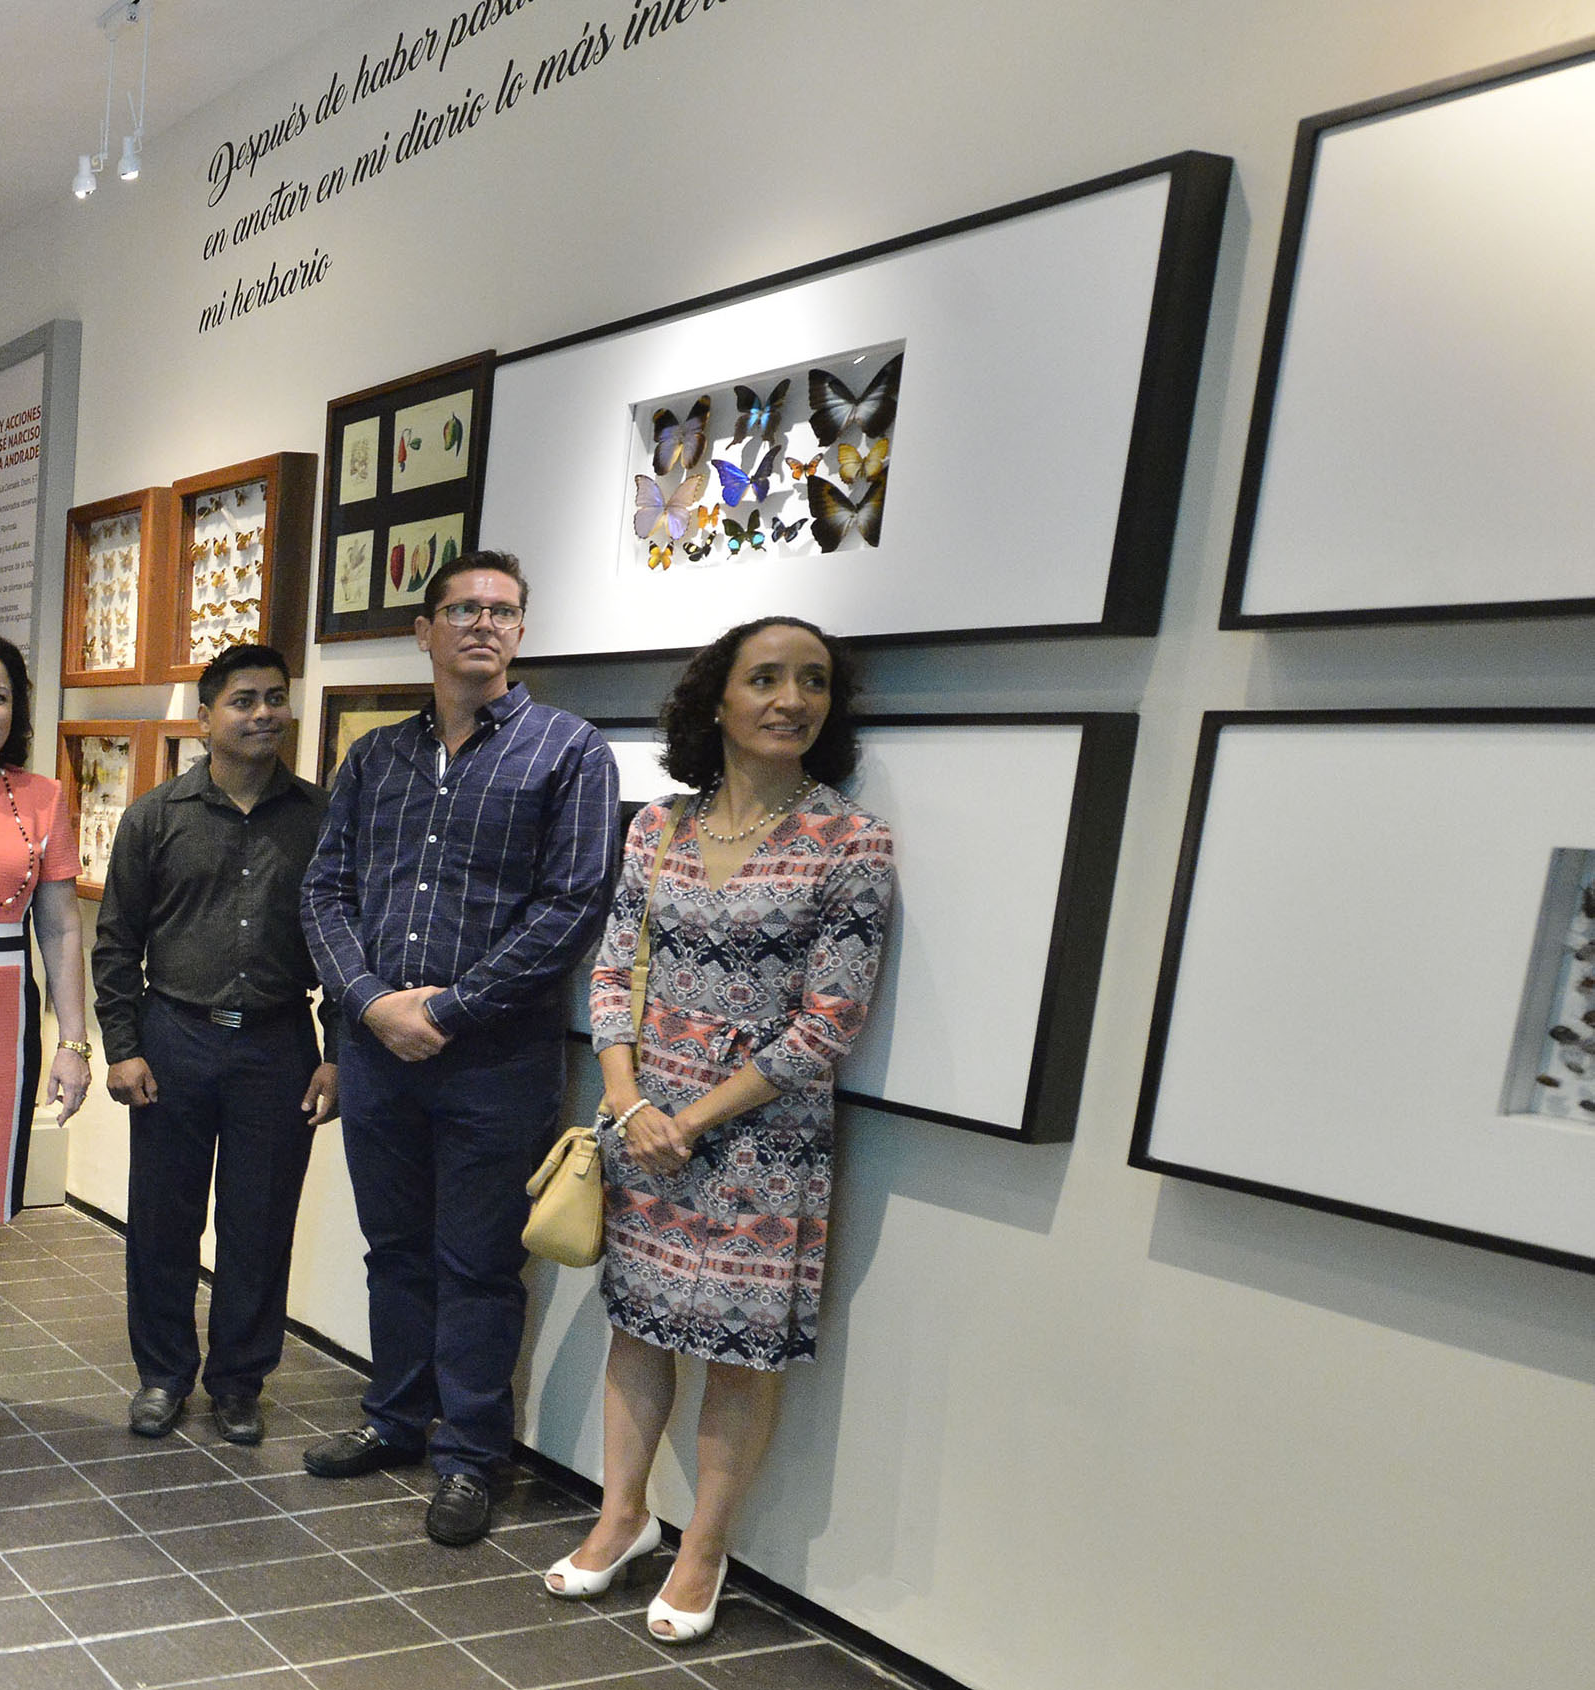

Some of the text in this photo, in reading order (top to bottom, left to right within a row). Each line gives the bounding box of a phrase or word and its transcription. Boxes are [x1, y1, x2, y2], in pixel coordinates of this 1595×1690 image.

[203, 228, 228, 260] en
[232, 181, 312, 246] anotar
[316, 166, 349, 204] en
[352, 131, 390, 187] mi
[395, 88, 490, 164] diario
[495, 59, 528, 115] lo
[532, 22, 616, 95] más
[208, 102, 309, 207] Después
[315, 72, 348, 125] de
[352, 28, 441, 104] haber
[198, 248, 333, 334] mi herbario
[0, 420, 5, 433] Y
[4, 404, 42, 430] ACCIONES
[8, 425, 41, 448] NARCISO
[4, 444, 40, 469] ANDRADE
